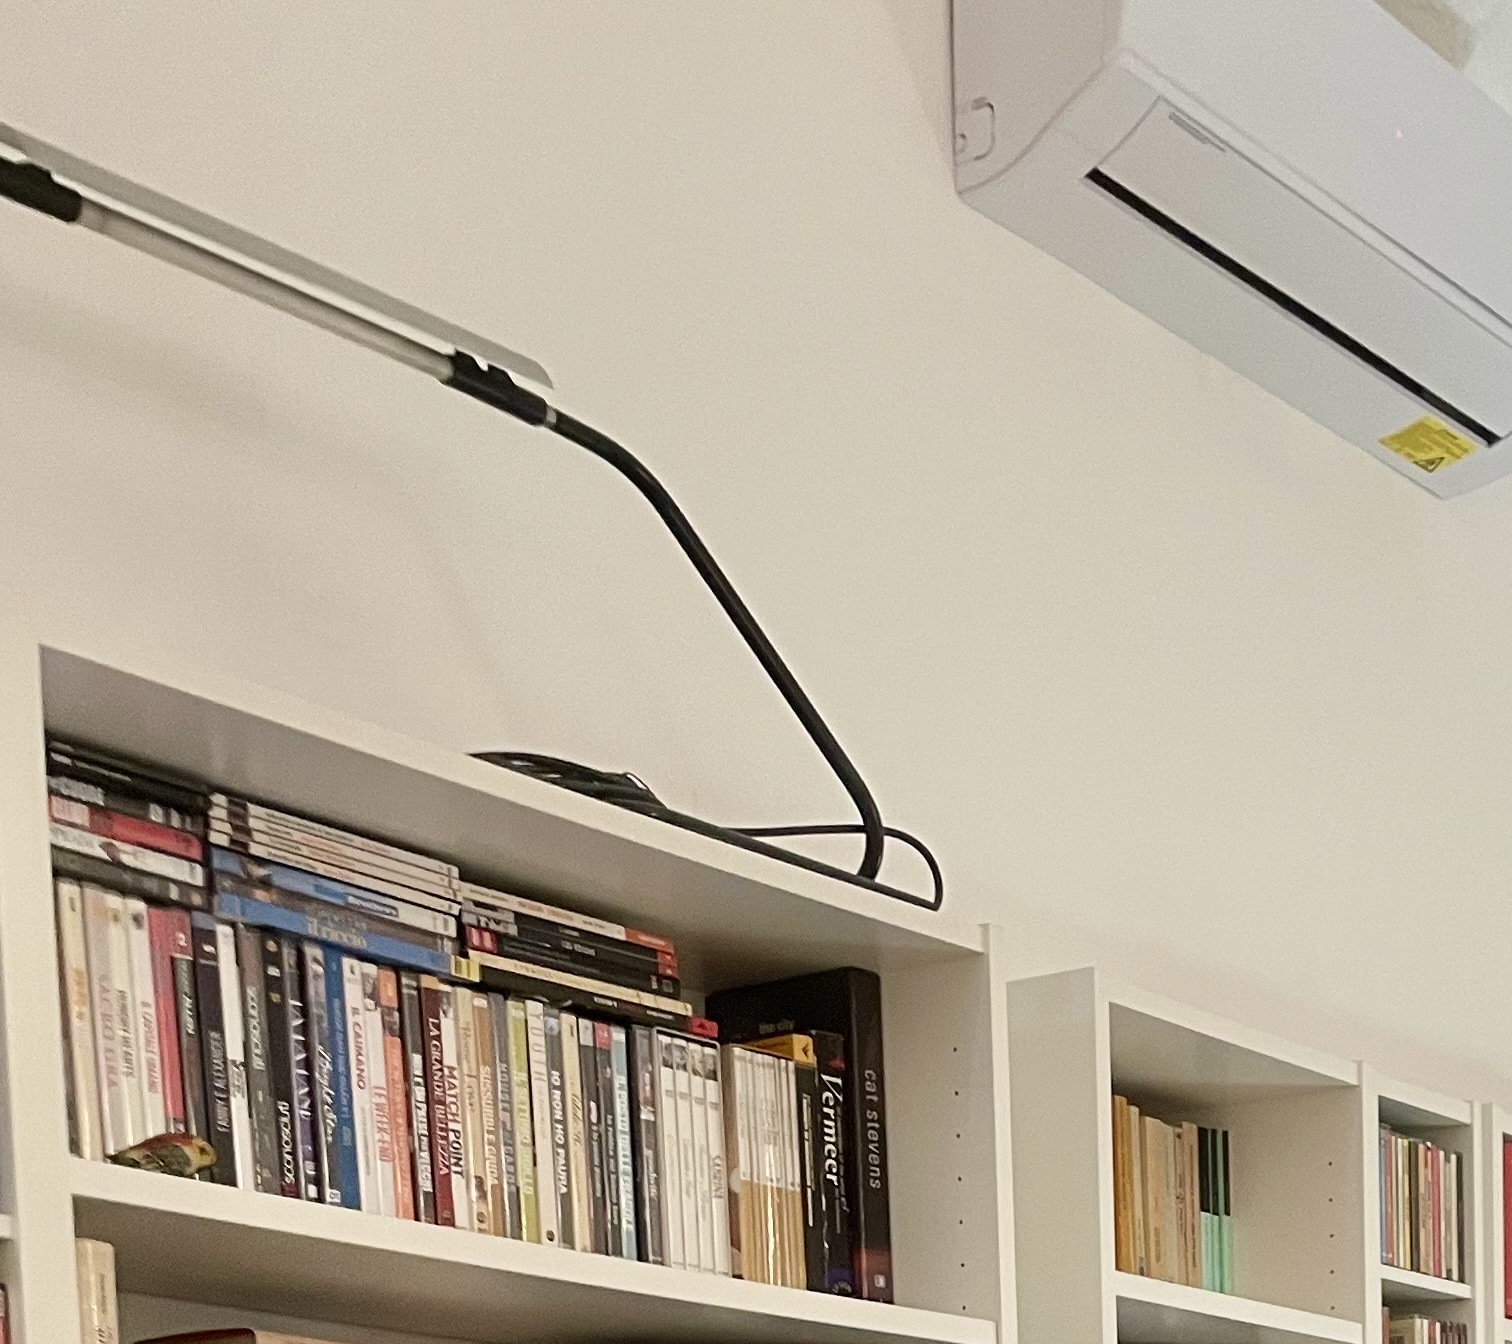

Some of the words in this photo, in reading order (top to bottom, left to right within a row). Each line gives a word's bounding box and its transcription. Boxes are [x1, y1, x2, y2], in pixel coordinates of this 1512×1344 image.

[428, 1017, 440, 1036] LA
[352, 1022, 368, 1090] CAIMANO
[430, 1040, 445, 1100] GRANDE
[551, 1071, 560, 1085] IO
[444, 1066, 461, 1123] MATCH
[552, 1090, 562, 1120] NON
[864, 1070, 877, 1101] cat
[434, 1104, 450, 1176] BELLEZZA
[450, 1128, 464, 1179] POINT
[553, 1124, 563, 1145] HO
[820, 1073, 843, 1186] Vermeer
[866, 1110, 882, 1189] stevens
[555, 1148, 567, 1194] PAURA
[711, 1155, 724, 1200] SABRINA
